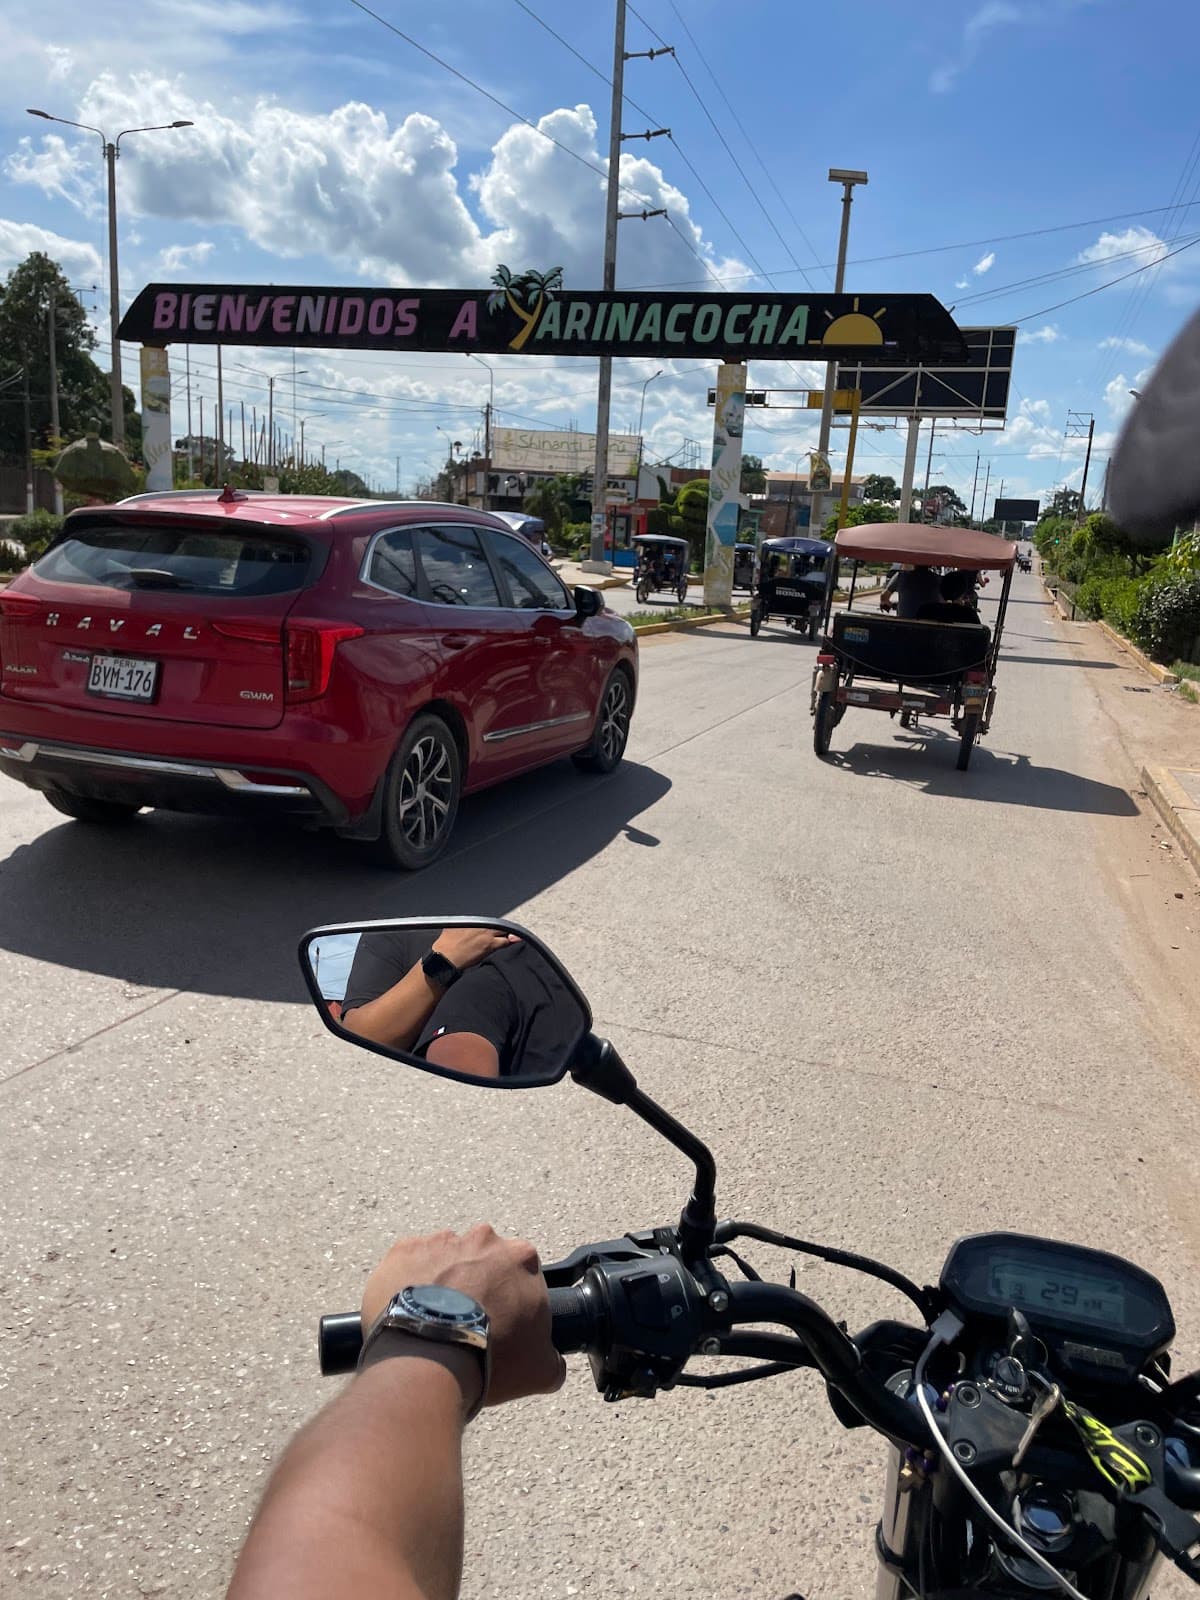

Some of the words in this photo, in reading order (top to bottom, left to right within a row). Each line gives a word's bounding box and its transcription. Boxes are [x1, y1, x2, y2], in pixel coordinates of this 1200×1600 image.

[152, 292, 421, 337] BIENVENIDOS
[448, 299, 479, 340] A
[45, 612, 198, 640] HAVAL
[113, 658, 138, 669] PERU
[90, 664, 152, 693] BYM-176
[239, 690, 275, 702] GWM
[1041, 1281, 1079, 1305] 29
